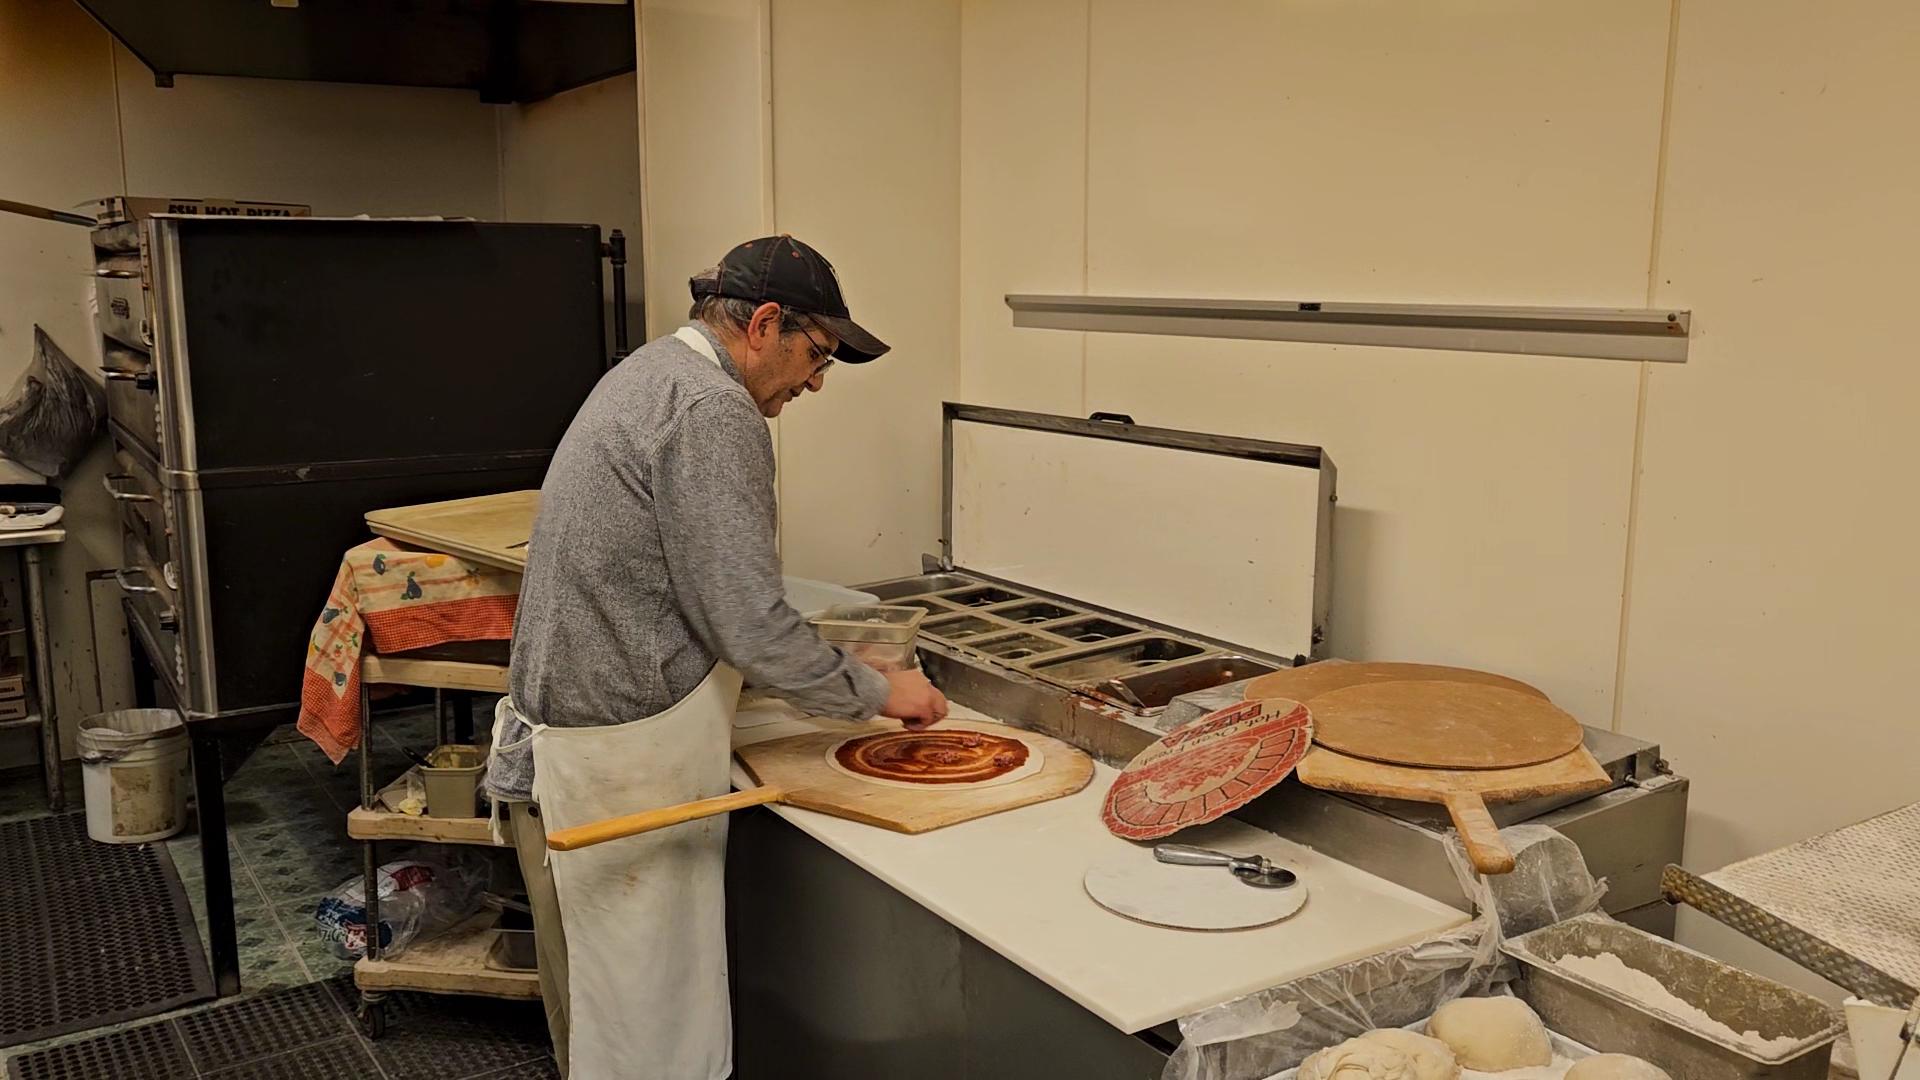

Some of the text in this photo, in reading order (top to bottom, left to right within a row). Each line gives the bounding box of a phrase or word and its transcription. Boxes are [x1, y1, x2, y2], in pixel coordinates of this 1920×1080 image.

[205, 206, 240, 216] HOT
[246, 208, 291, 217] PIZZA
[1161, 703, 1262, 748] PIZZA
[1191, 727, 1238, 746] Oven
